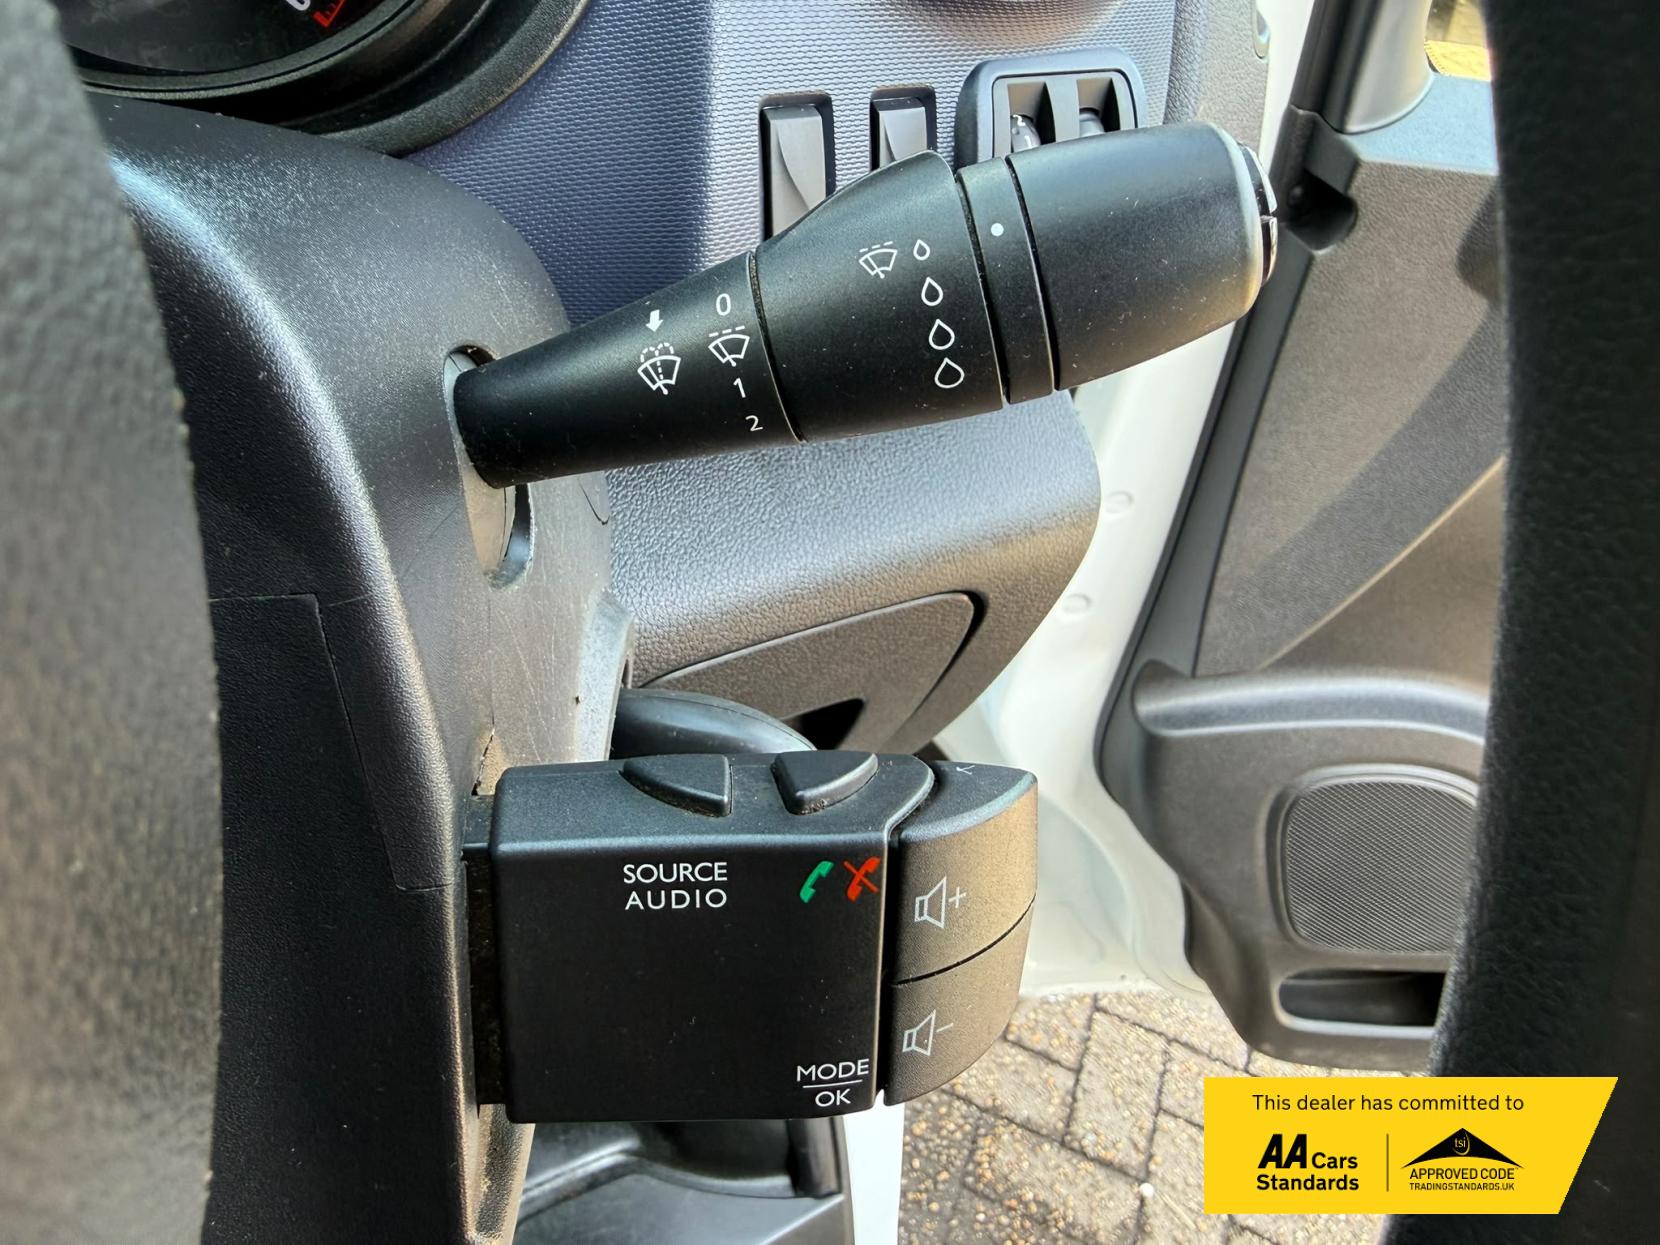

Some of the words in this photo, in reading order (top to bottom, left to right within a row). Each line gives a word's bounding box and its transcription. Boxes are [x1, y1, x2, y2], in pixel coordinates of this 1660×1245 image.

[715, 293, 732, 316] 0
[733, 377, 746, 398] 1
[745, 414, 764, 432] 2
[623, 861, 728, 884] SOURCE
[625, 888, 727, 911] AUDIO
[796, 1058, 870, 1083] MODE
[814, 1088, 852, 1108] OK
